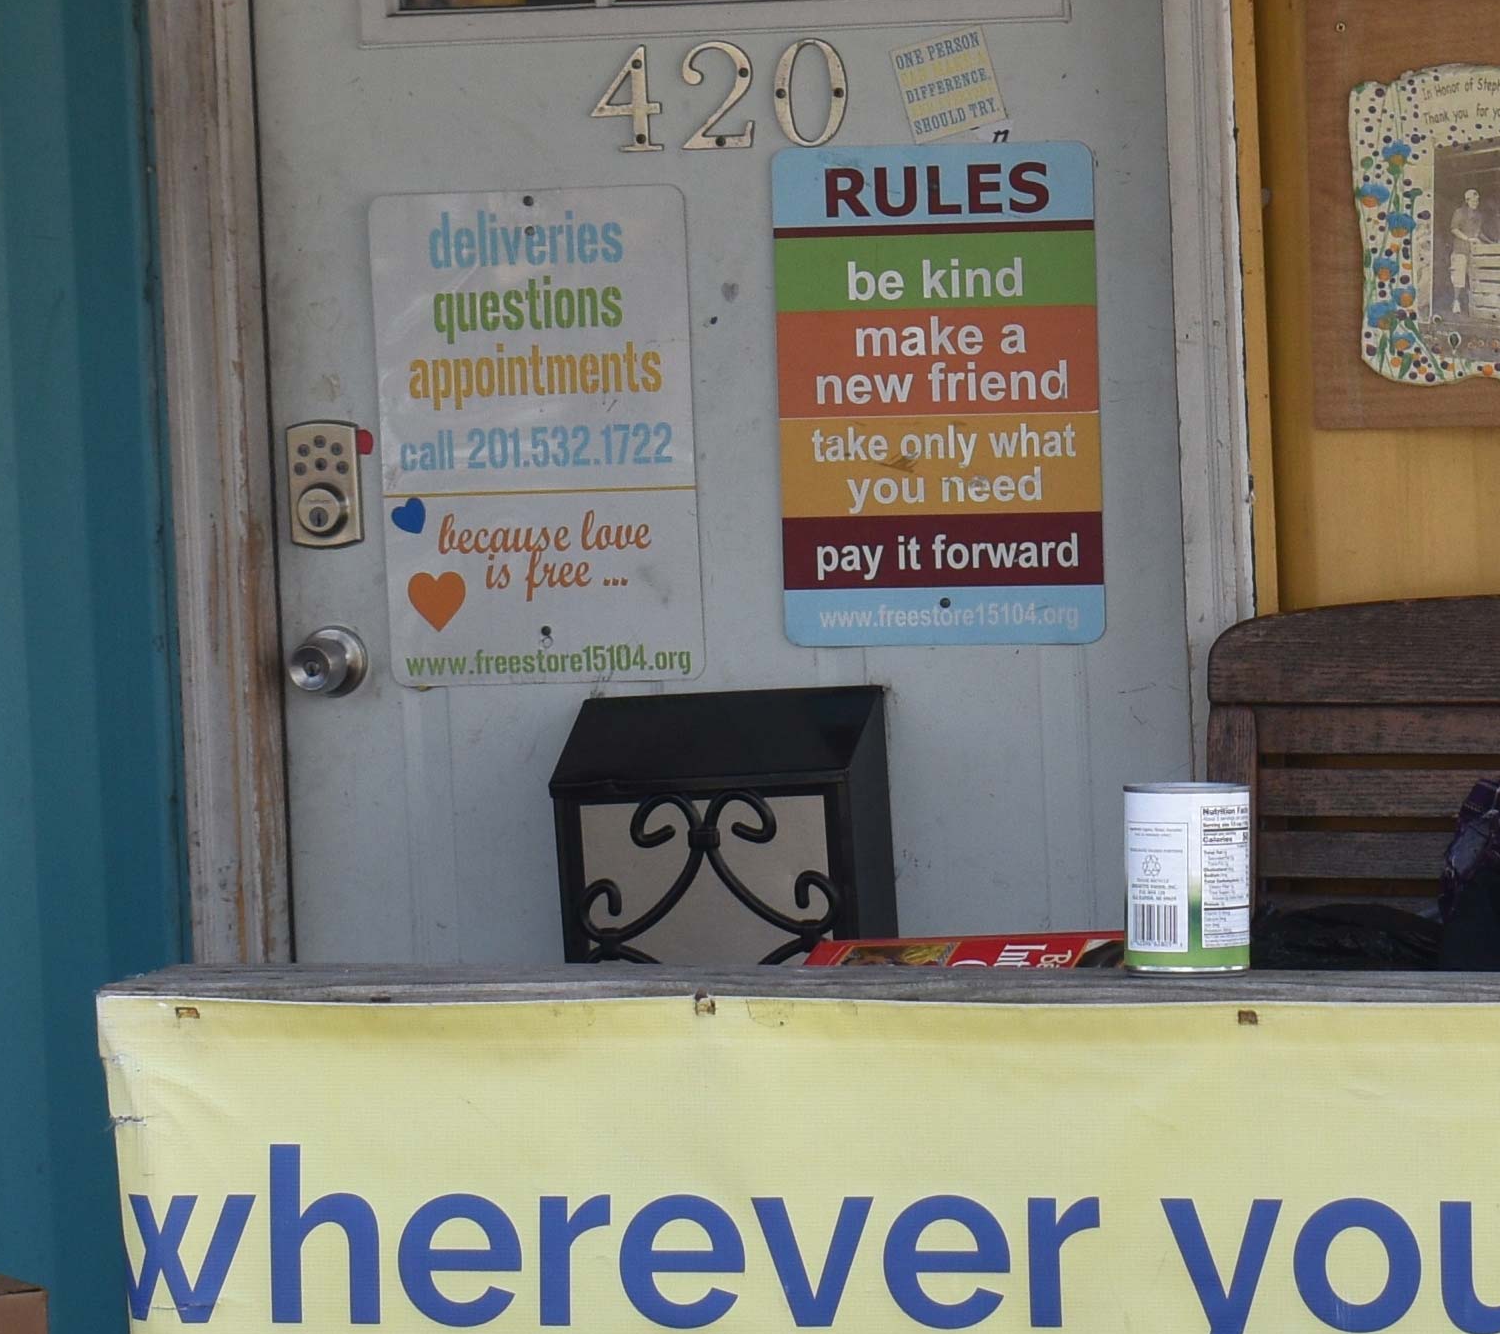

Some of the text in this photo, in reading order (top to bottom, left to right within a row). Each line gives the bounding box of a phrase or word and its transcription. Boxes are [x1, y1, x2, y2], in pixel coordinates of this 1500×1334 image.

[896, 49, 924, 70] ONE
[927, 32, 980, 61] PERSON
[590, 37, 848, 153] 420
[914, 108, 966, 135] SHOULD
[968, 97, 1000, 118] TRY.
[1423, 111, 1449, 125] Thank
[1452, 109, 1468, 127] you
[1476, 103, 1489, 117] for
[824, 161, 1050, 218] RULES
[429, 209, 624, 269] deliveries
[847, 257, 1024, 301] be kind
[433, 275, 623, 345] questions
[855, 315, 1027, 357] make a
[408, 341, 662, 411] appointments
[816, 359, 1068, 405] new friend
[400, 421, 673, 472] call 201.532.1722
[812, 423, 1077, 468] take only what
[847, 466, 1042, 515] you need
[438, 509, 652, 556] because love
[817, 532, 1079, 581] pay it forward
[485, 547, 592, 603] is free
[820, 602, 1079, 631] www.freestore15104.org
[406, 644, 692, 677] www.freestore15104.org
[128, 1143, 1100, 1332] wherever
